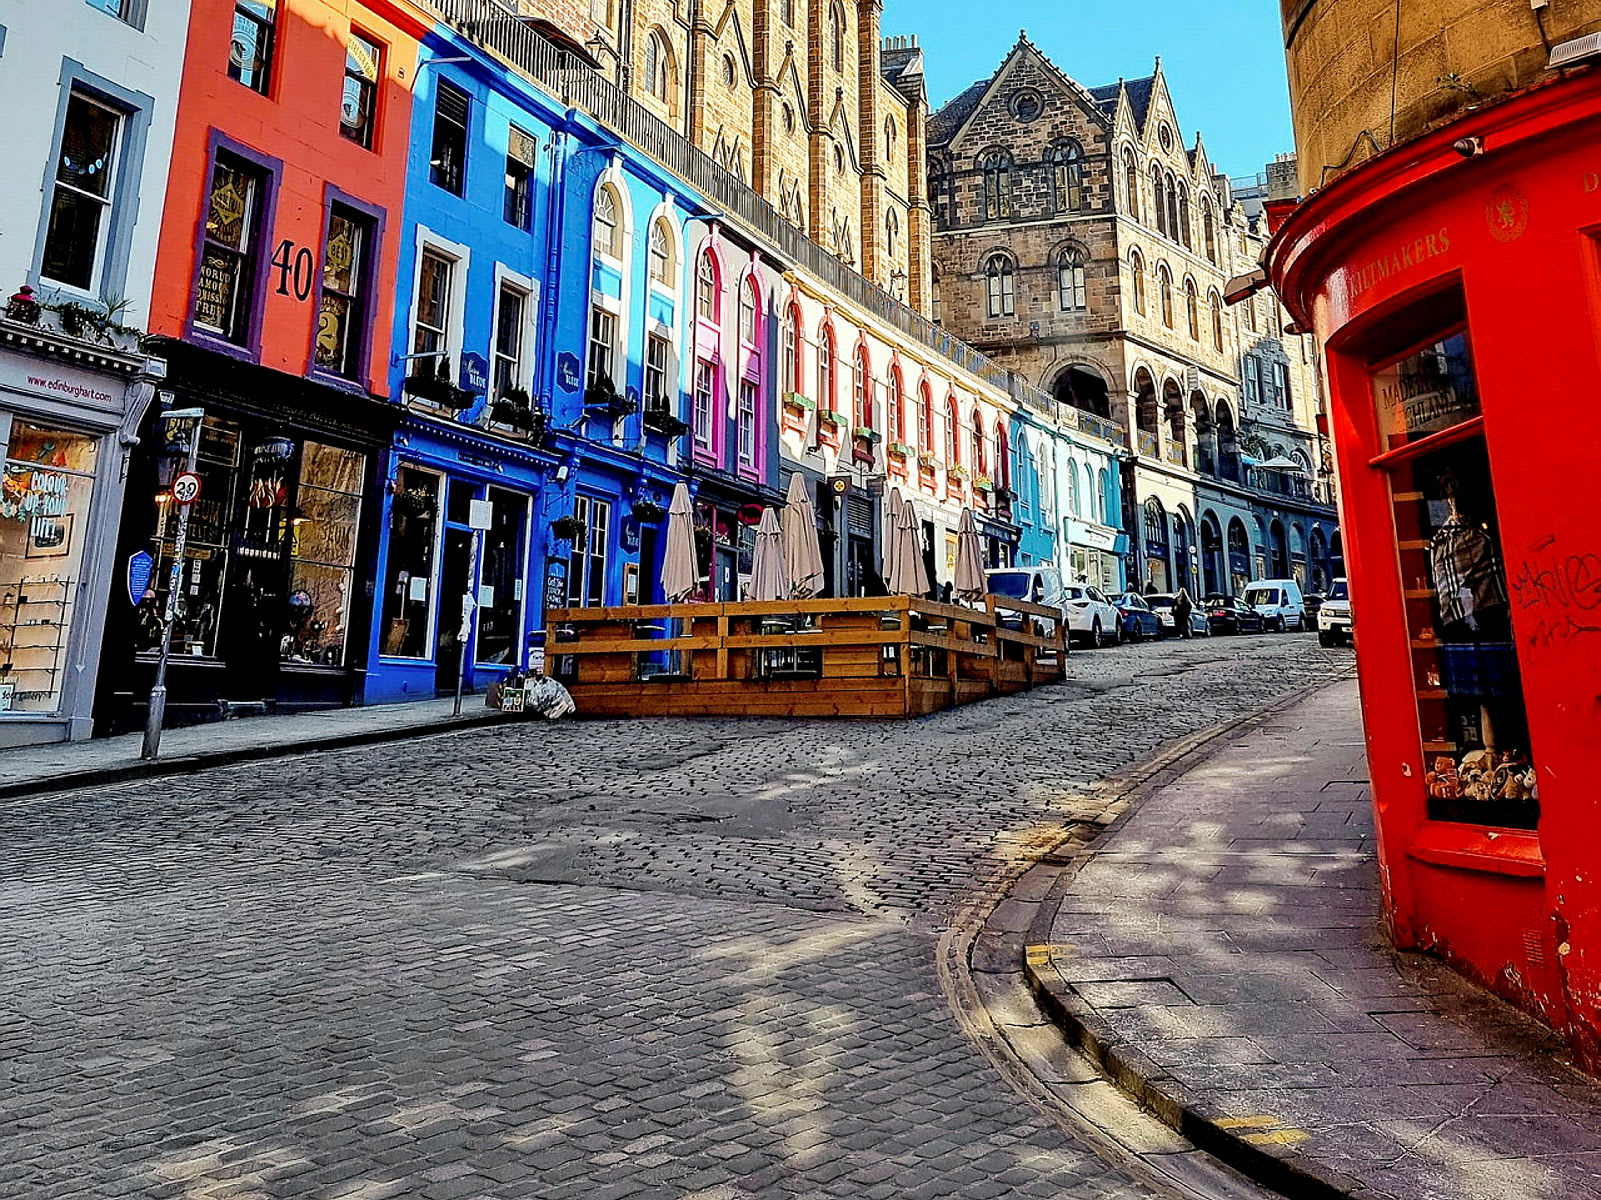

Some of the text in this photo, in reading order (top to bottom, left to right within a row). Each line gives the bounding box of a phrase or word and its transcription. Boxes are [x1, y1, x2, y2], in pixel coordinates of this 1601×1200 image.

[271, 240, 313, 301] 40
[1350, 227, 1450, 299] KILTMAKERS
[27, 376, 112, 402] www.edinburghart.com
